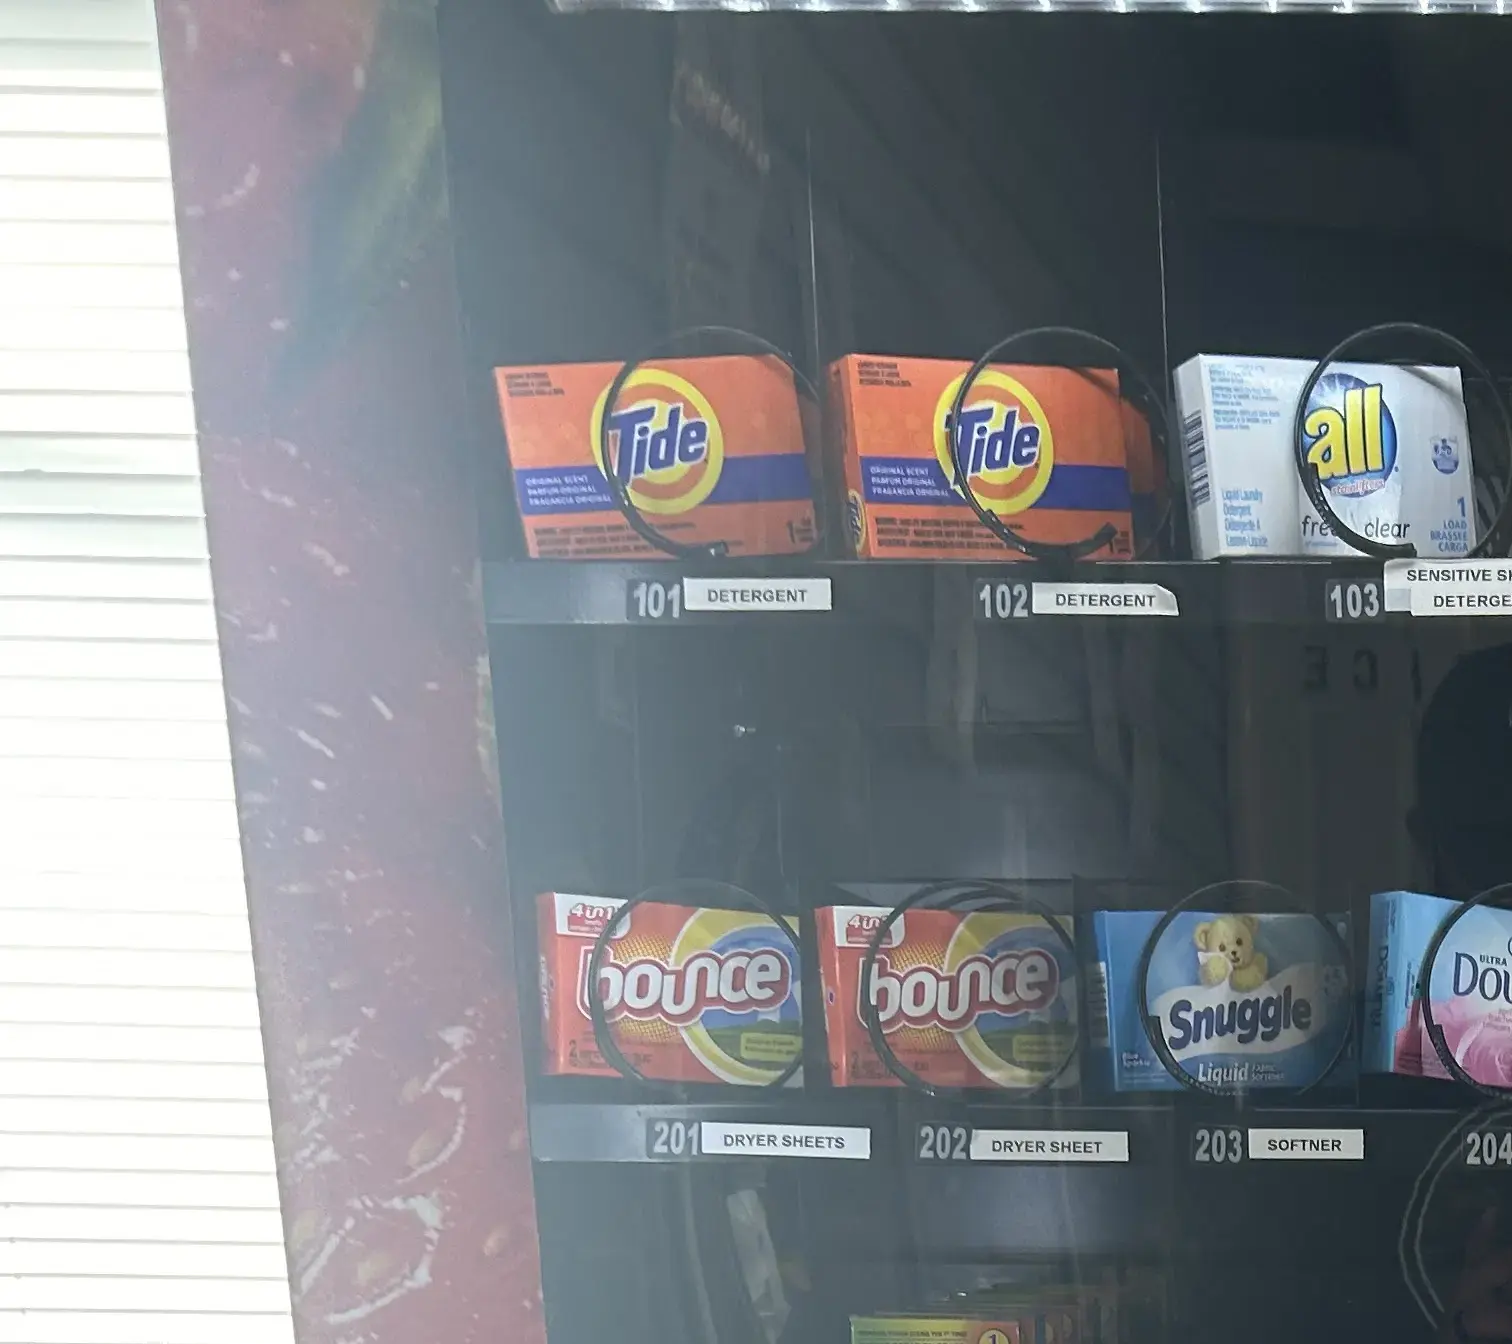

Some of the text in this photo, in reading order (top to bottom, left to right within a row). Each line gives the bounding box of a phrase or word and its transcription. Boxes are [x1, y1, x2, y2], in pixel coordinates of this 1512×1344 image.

[609, 404, 708, 487] Tide
[945, 405, 1040, 488] Tide
[1304, 383, 1384, 480] all
[1364, 517, 1410, 538] clear
[1406, 569, 1492, 583] SENSITIVE
[633, 581, 808, 619] 101 DETERGENT
[979, 583, 1157, 619] 102 DETERGENT
[1329, 583, 1380, 619] 103
[1479, 954, 1507, 967] ULTRA
[586, 946, 783, 1014] bounce
[869, 951, 1057, 1021] bounce
[1168, 985, 1312, 1051] Snuggle
[1196, 1062, 1249, 1084] Liquid
[653, 1120, 846, 1155] 201 DRYER SHEETS
[919, 1125, 1103, 1160] 202 DRYER SHEET
[1195, 1129, 1343, 1163] 203 SOFTNER
